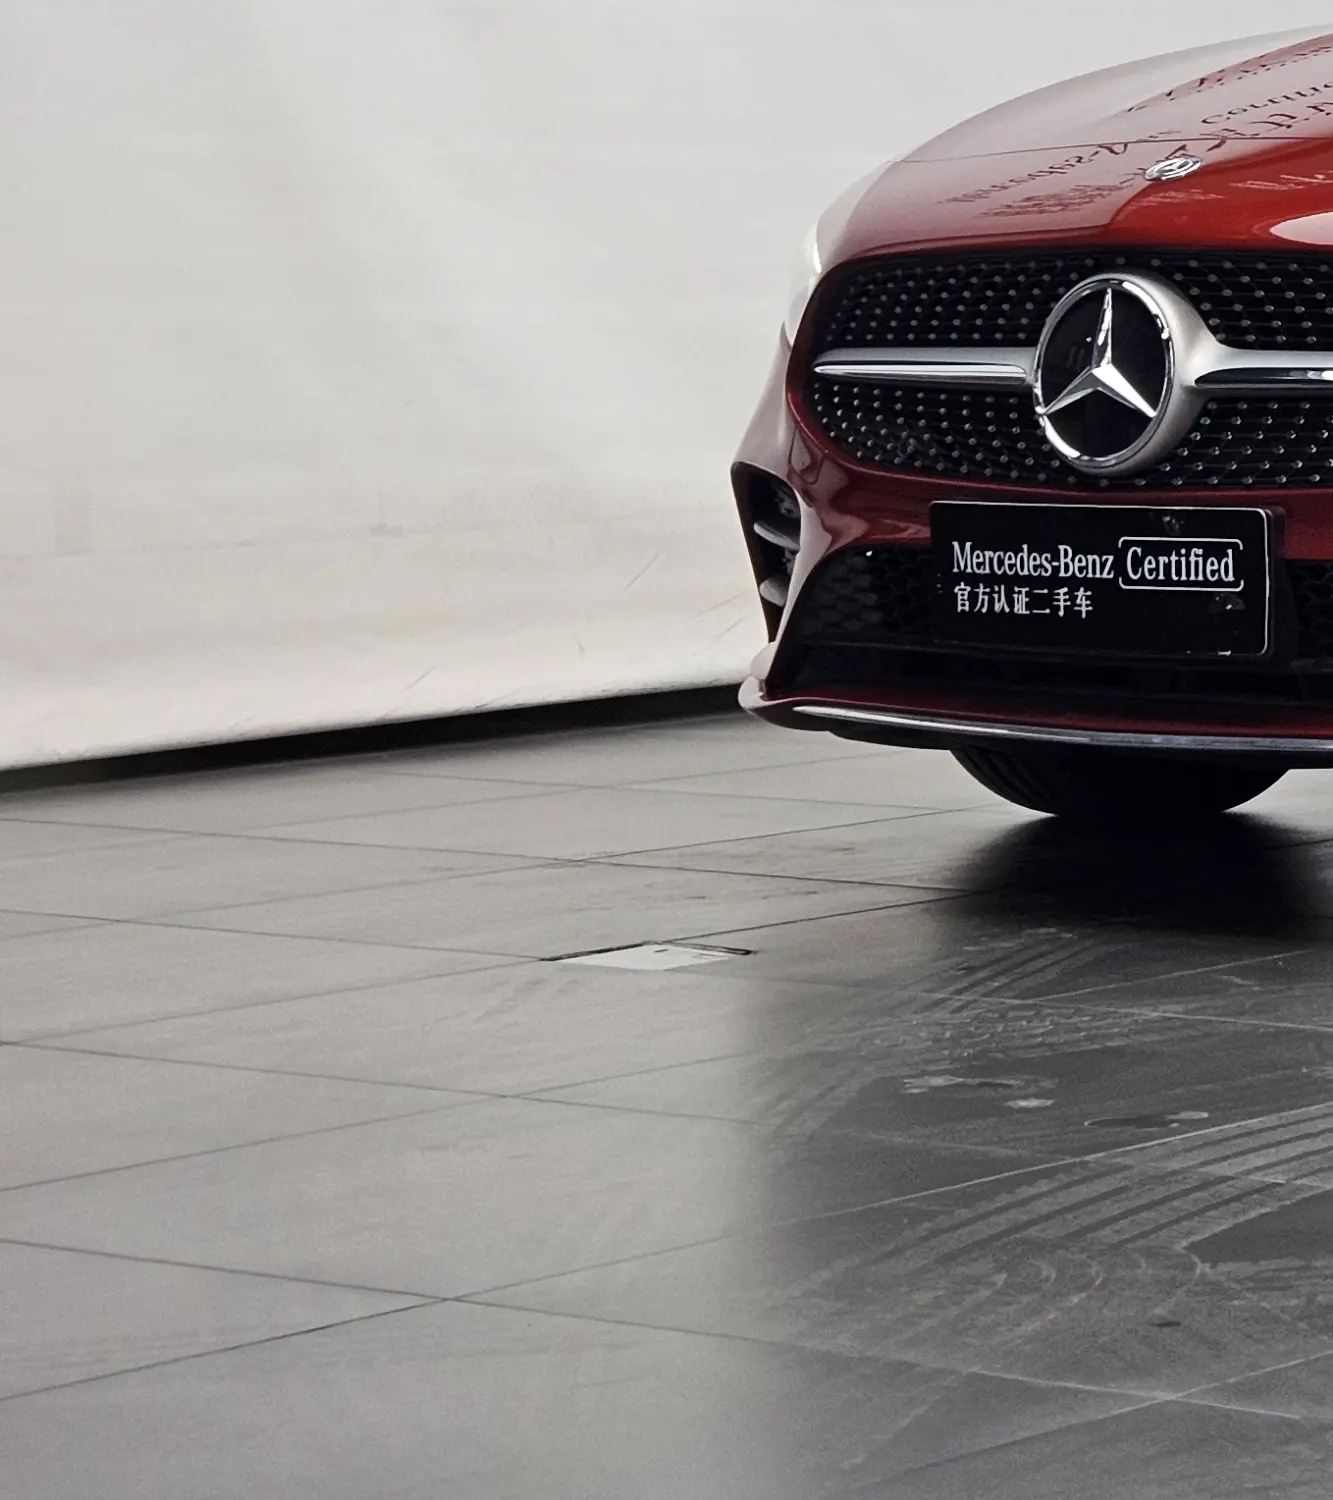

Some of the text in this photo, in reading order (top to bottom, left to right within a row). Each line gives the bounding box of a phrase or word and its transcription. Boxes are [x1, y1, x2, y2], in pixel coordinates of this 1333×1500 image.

[951, 540, 1237, 582] Mercedes-Benz Certified
[953, 580, 1095, 620] 官方认证二手车
